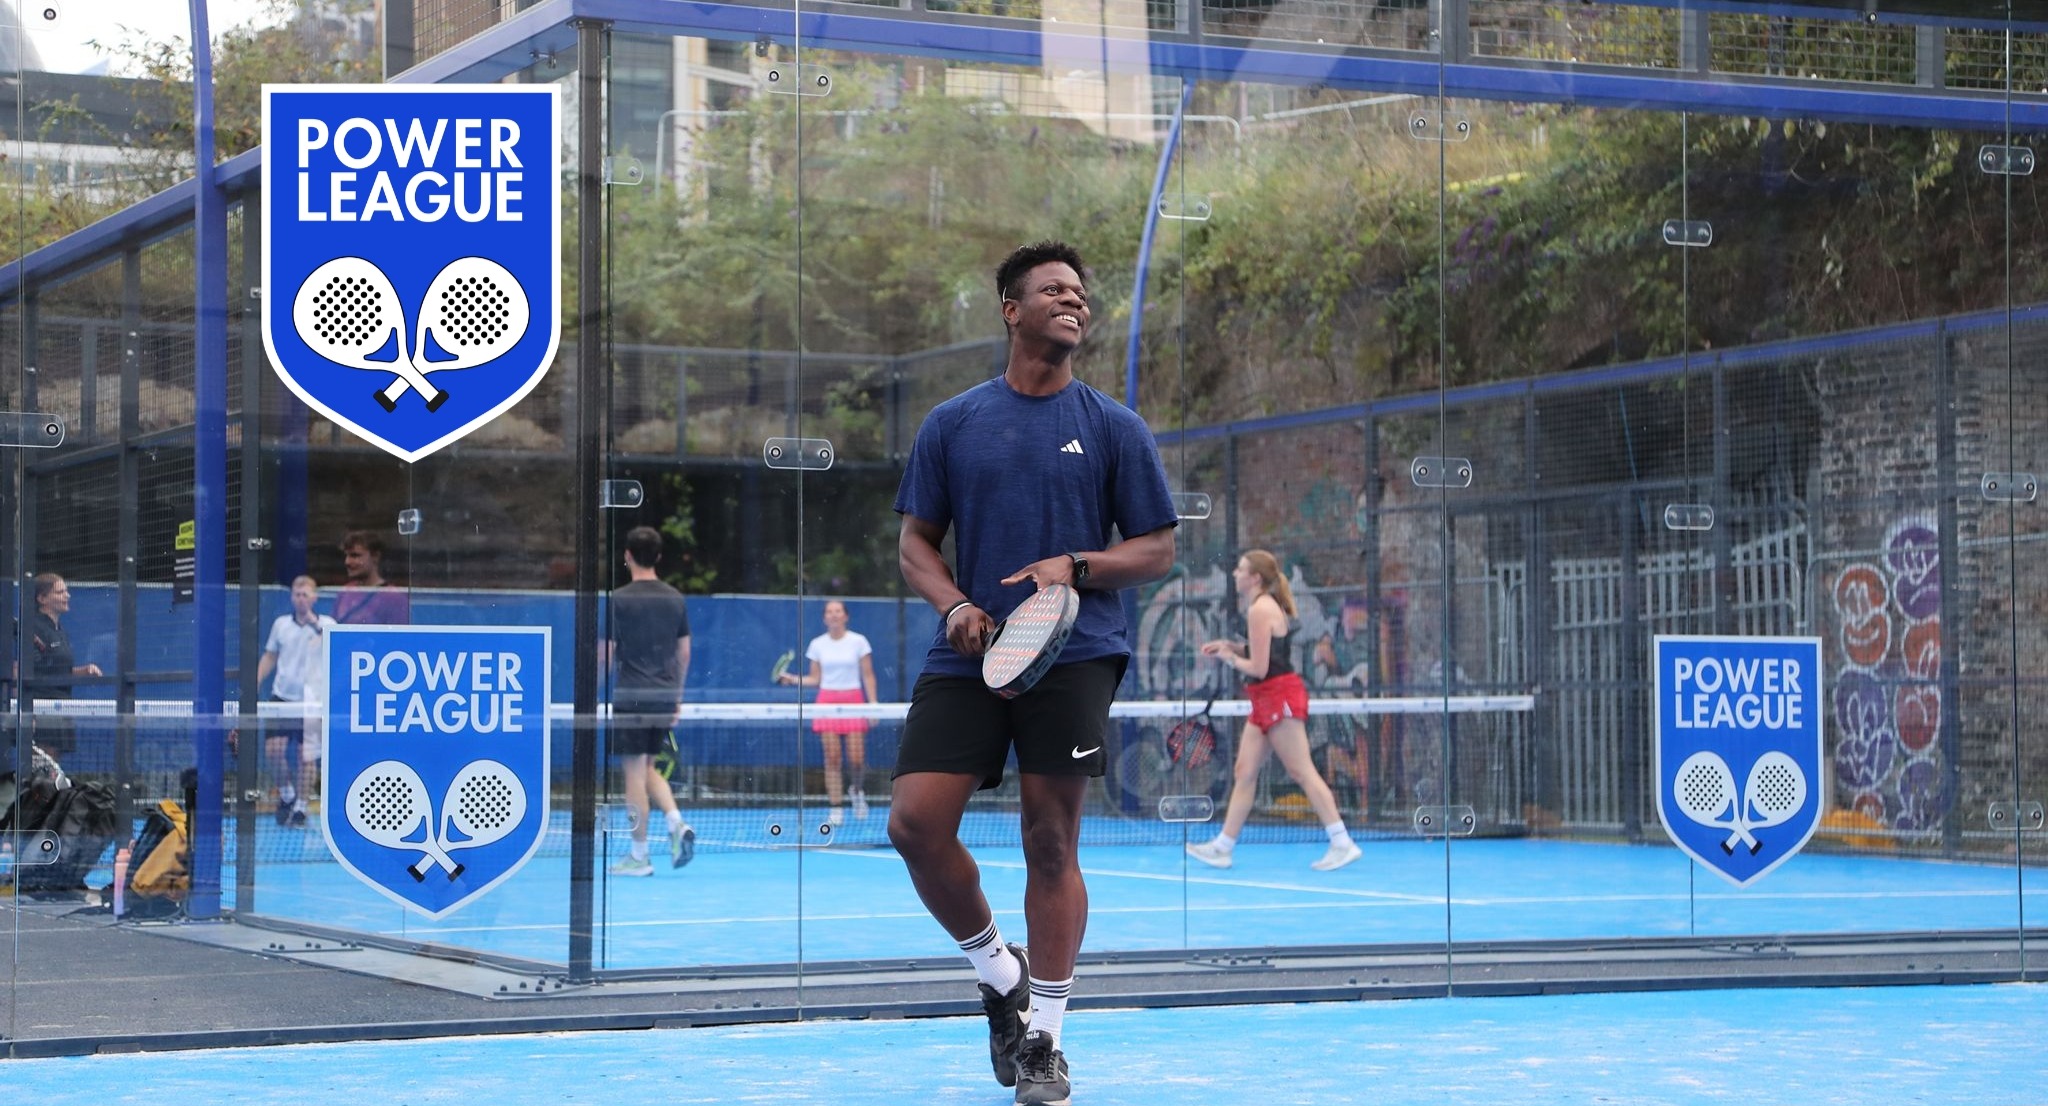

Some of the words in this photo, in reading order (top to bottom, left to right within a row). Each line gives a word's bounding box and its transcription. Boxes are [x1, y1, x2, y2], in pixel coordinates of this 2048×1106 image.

[350, 651, 524, 691] POWER
[1675, 657, 1802, 693] POWER
[350, 692, 523, 734] LEAGUE
[1675, 693, 1803, 729] LEAGUE
